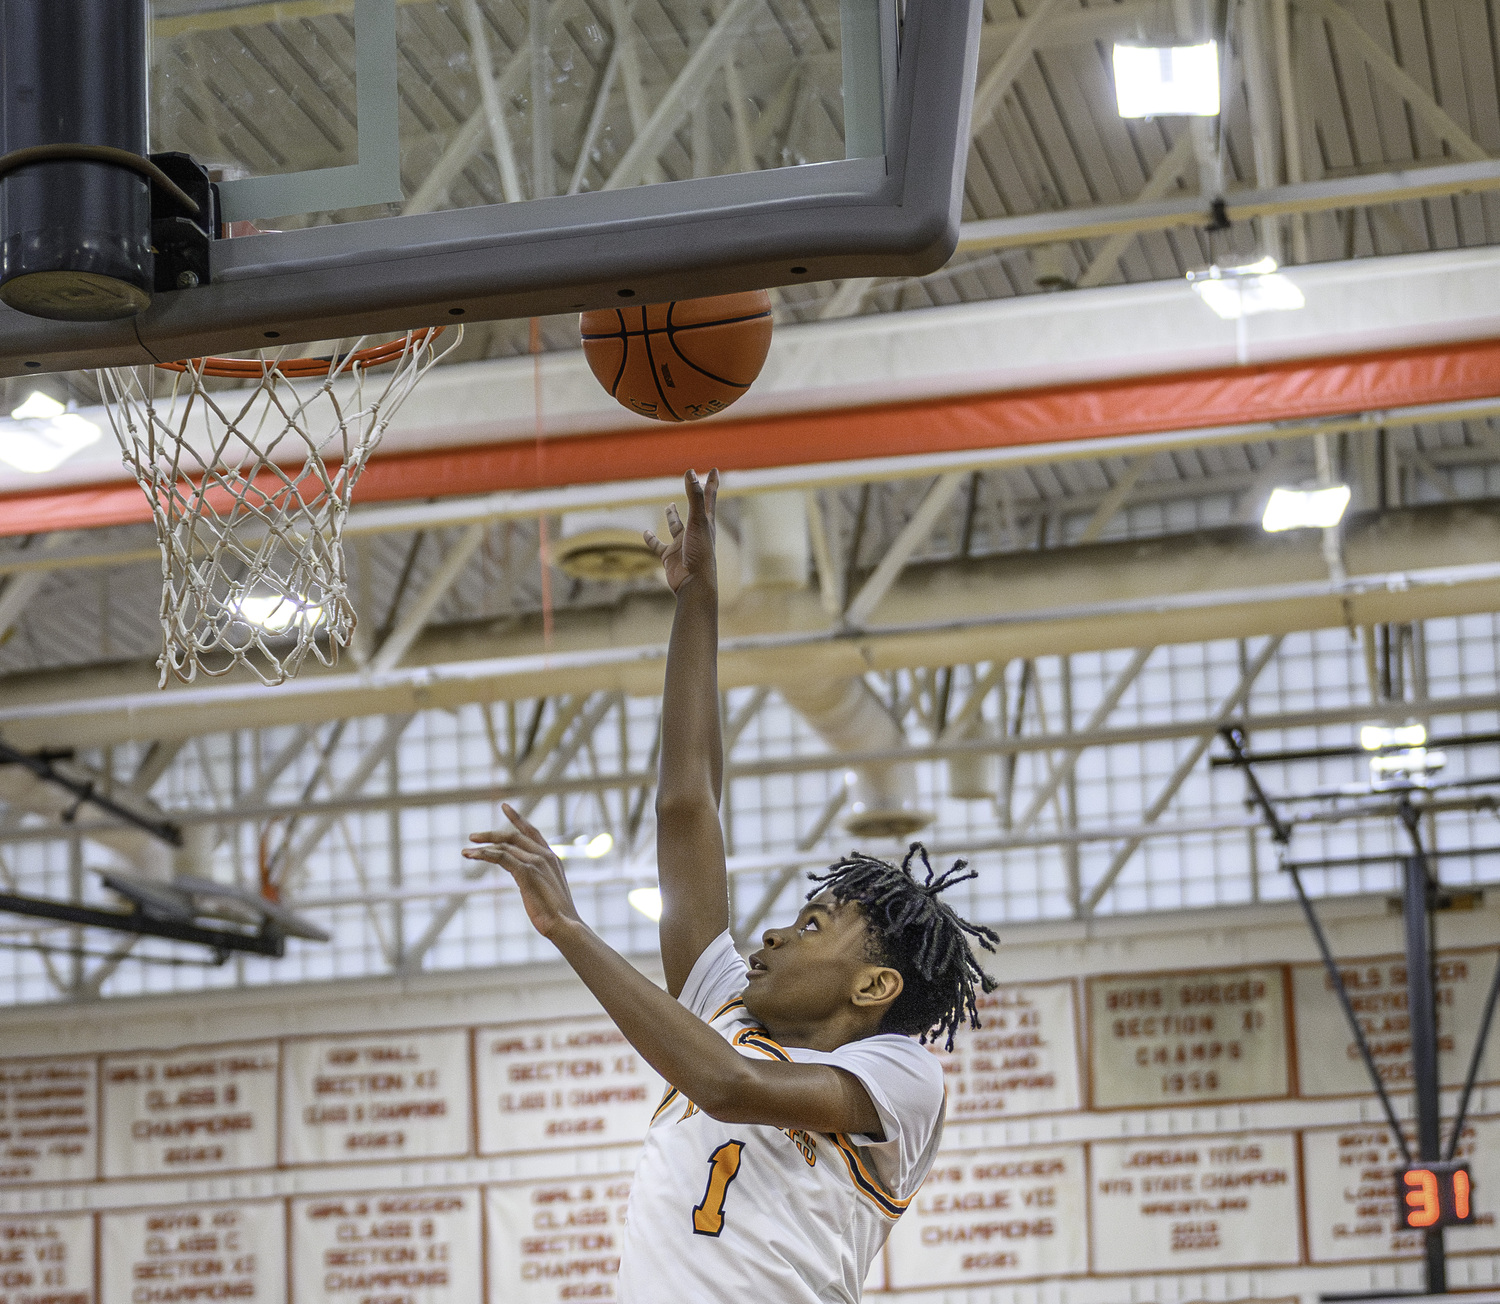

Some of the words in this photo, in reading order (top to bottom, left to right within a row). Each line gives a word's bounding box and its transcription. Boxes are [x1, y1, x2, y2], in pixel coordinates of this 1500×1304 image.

[1112, 1016, 1215, 1039] SECTION
[1136, 1041, 1242, 1066] CHAMPS
[692, 1139, 746, 1237] 1
[1404, 1169, 1470, 1227] 31
